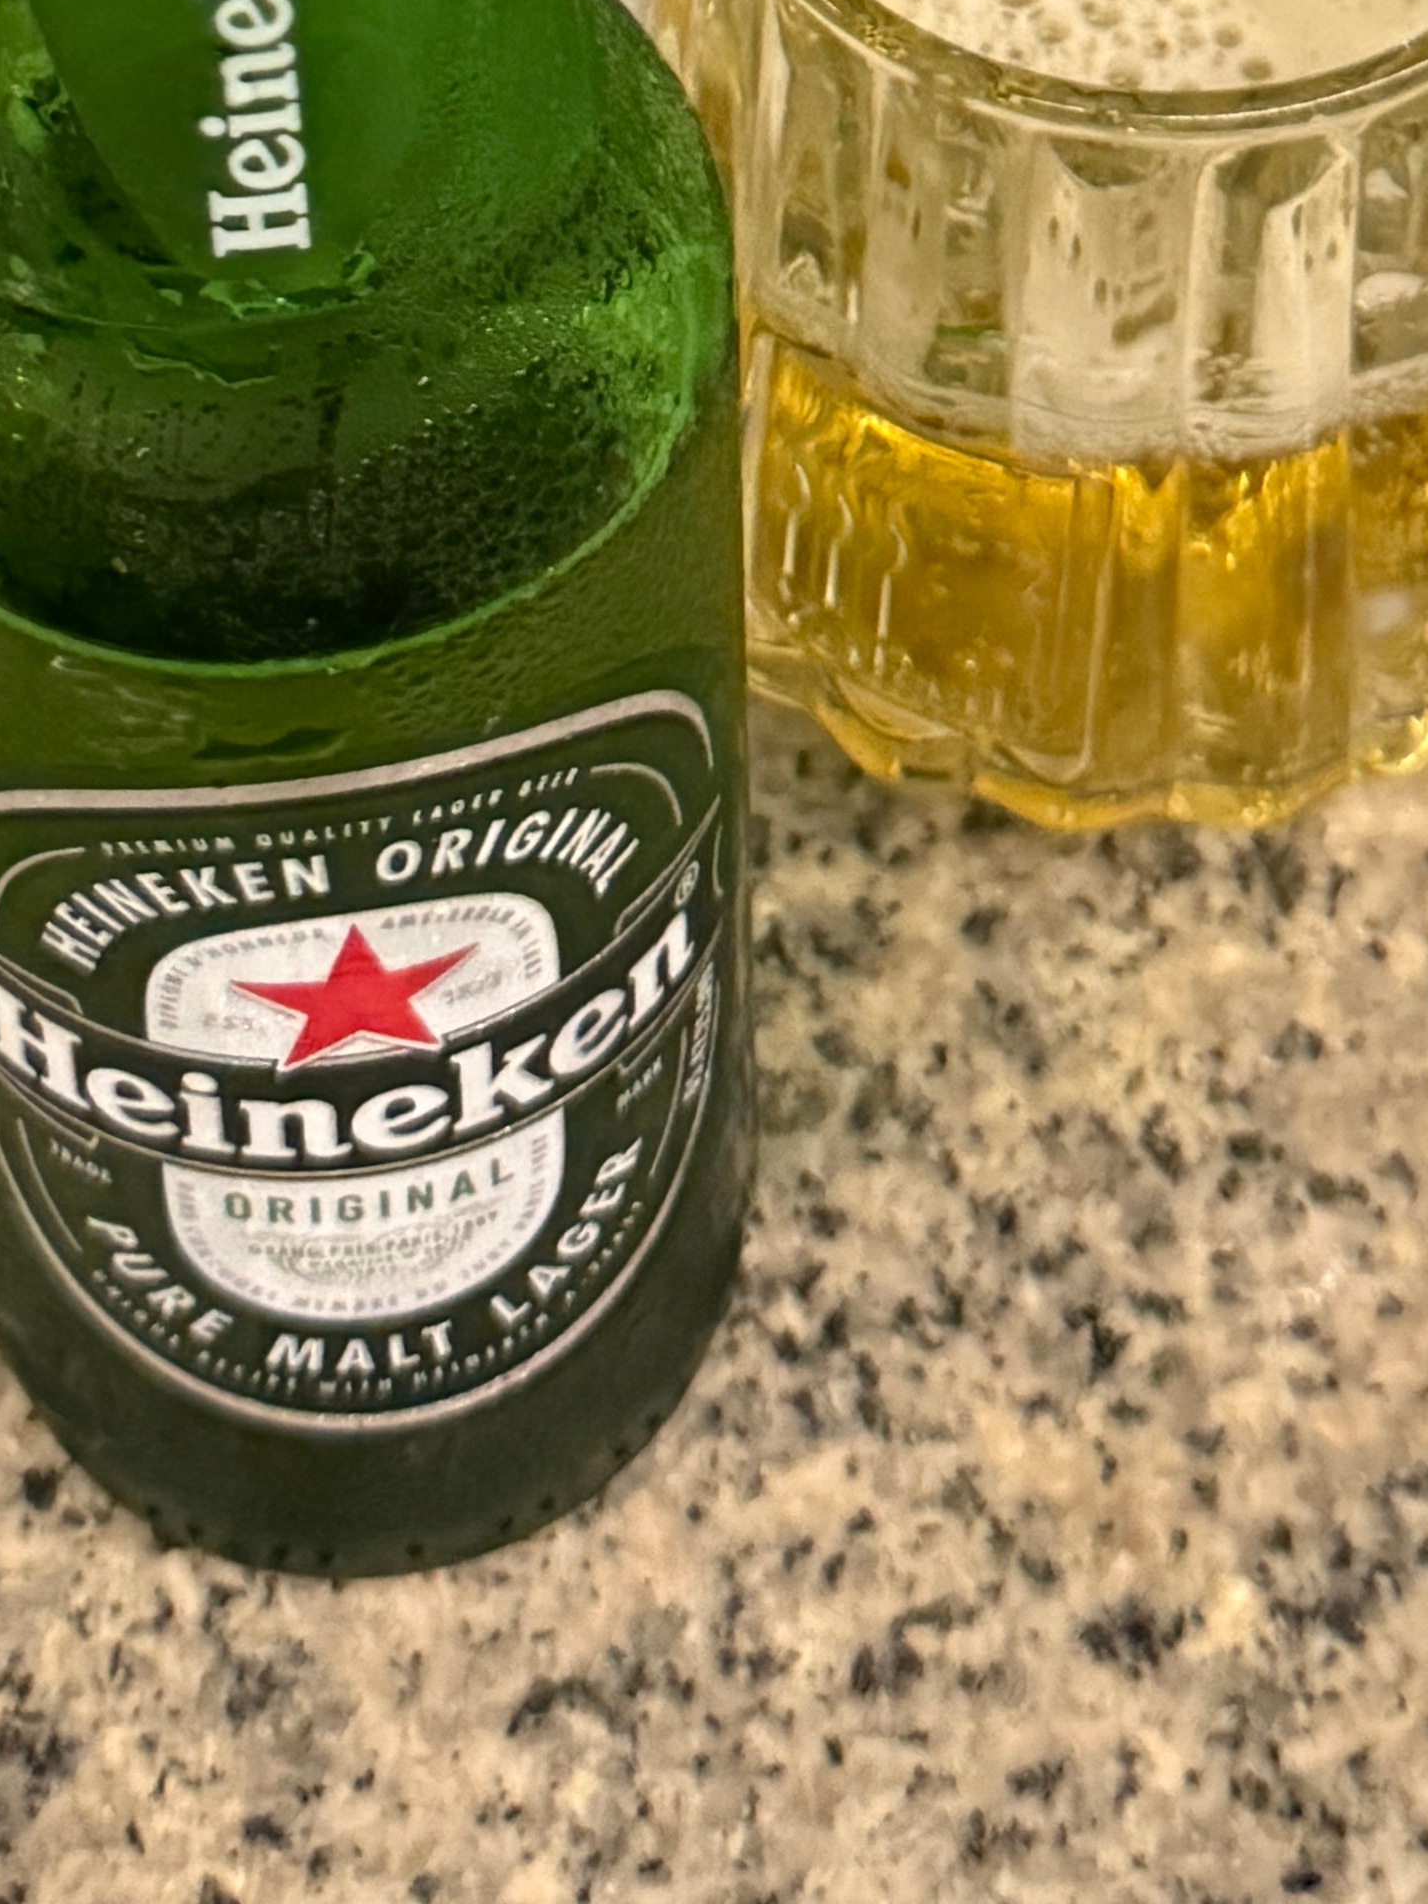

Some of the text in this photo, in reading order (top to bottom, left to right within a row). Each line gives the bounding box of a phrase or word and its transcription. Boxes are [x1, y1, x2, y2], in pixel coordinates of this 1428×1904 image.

[256, 815, 393, 847] QUALITY
[41, 807, 640, 975] HEINEKEN ORIGINAL
[224, 1157, 514, 1225] ORIGINAL
[86, 1215, 234, 1342] PURE
[266, 1318, 453, 1374] MALT
[490, 1136, 643, 1326] LAGER
